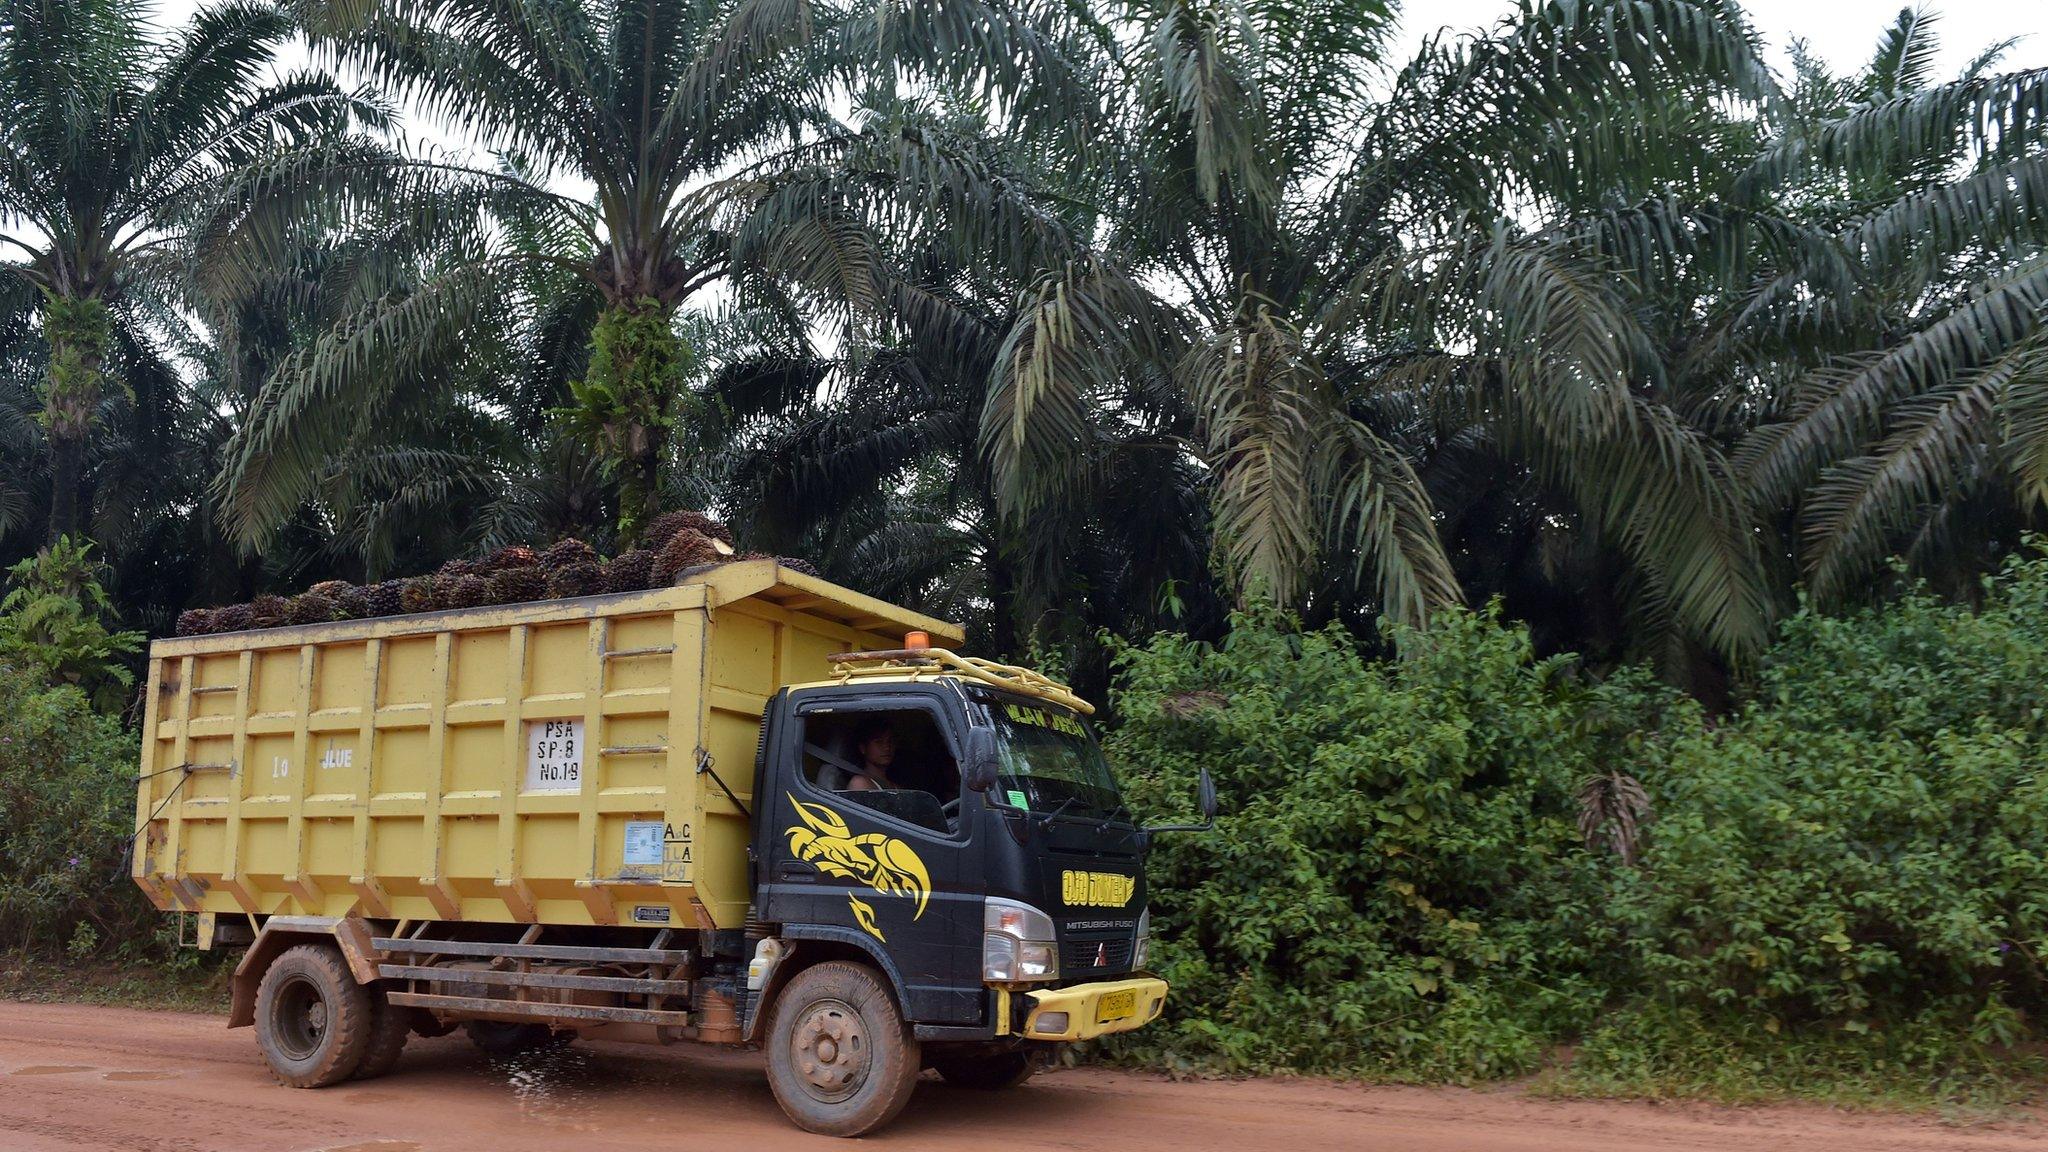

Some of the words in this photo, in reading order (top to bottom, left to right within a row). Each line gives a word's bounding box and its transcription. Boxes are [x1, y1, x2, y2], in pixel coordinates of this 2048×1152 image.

[545, 720, 573, 738] PSA
[1066, 920, 1114, 930] MITSUBISHI
[1114, 920, 1134, 929] FUSO
